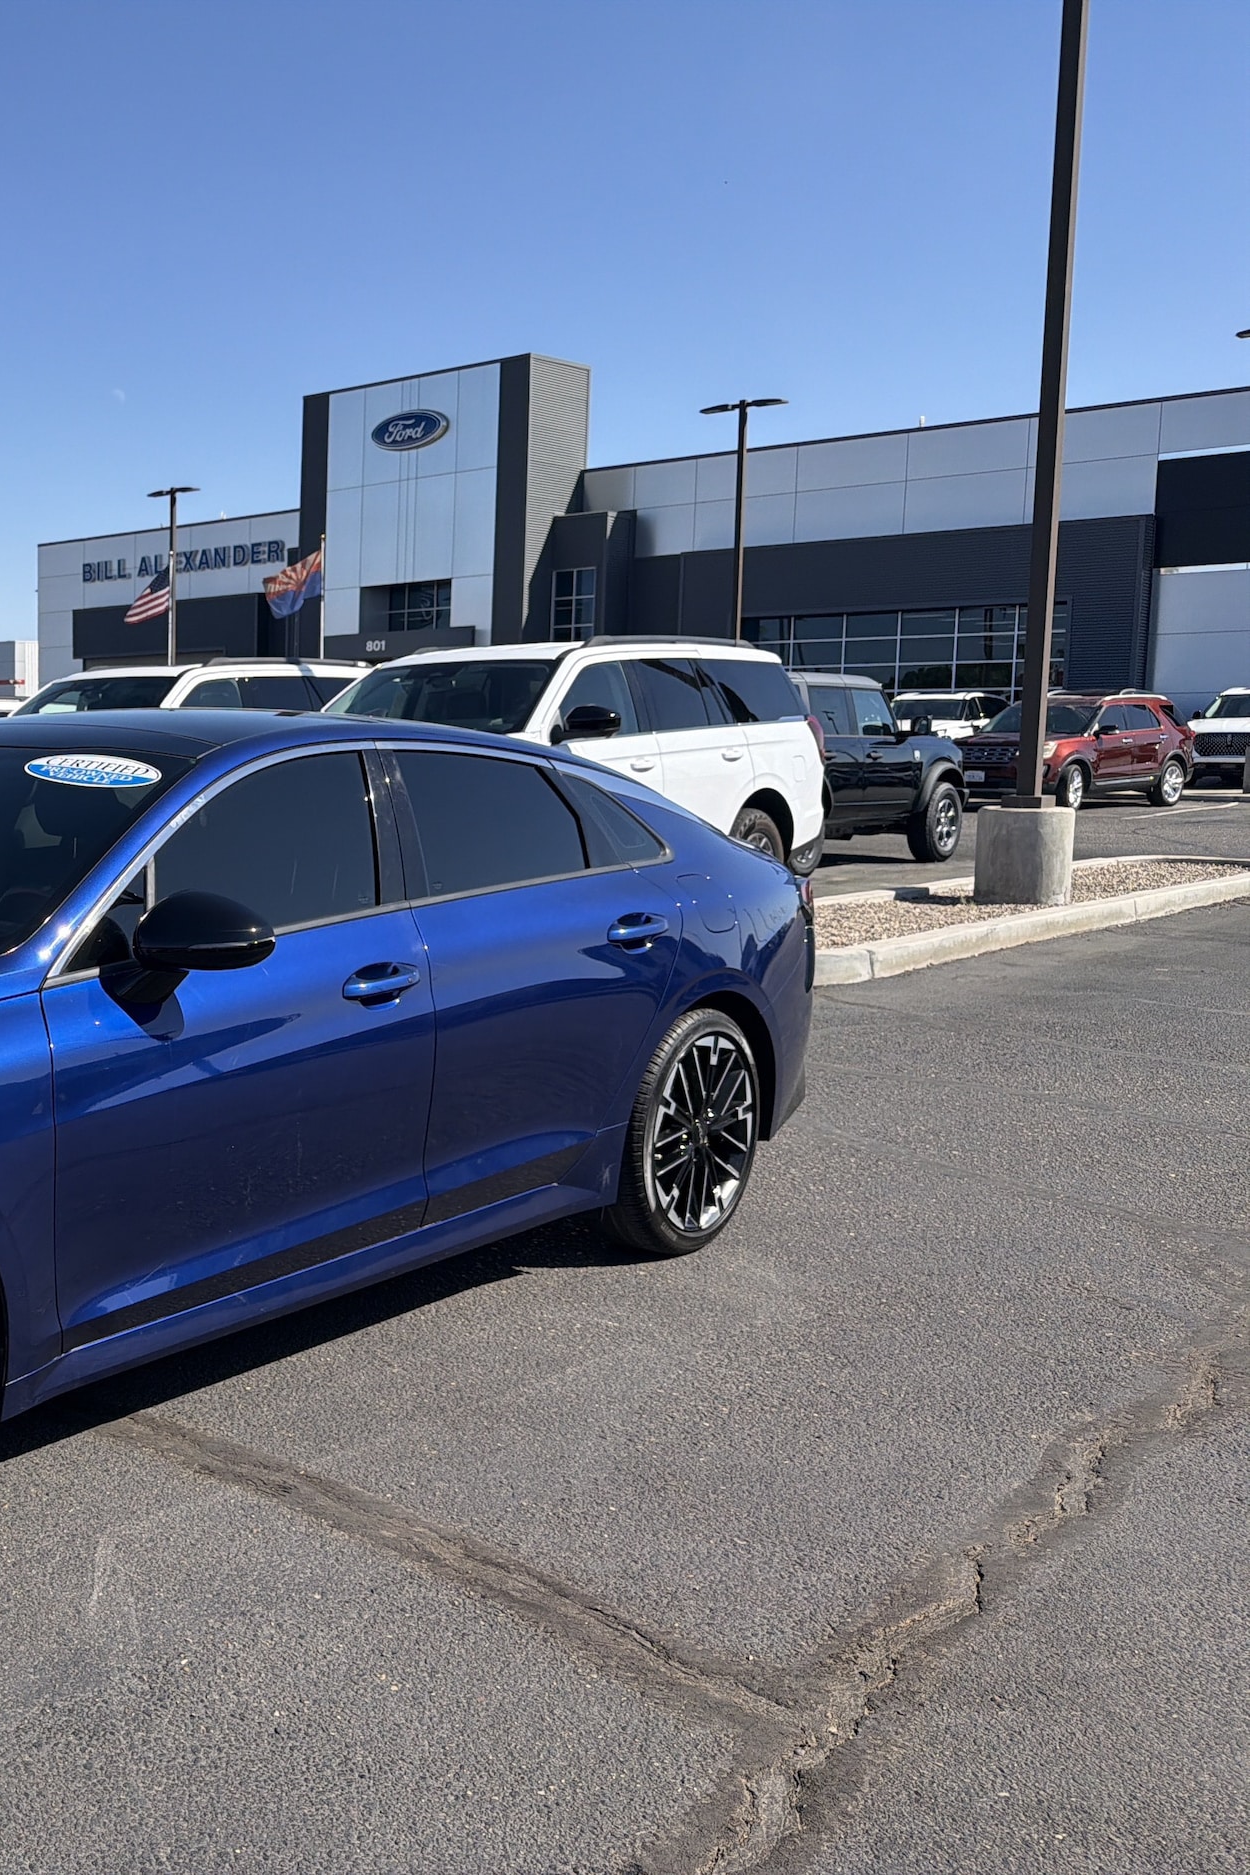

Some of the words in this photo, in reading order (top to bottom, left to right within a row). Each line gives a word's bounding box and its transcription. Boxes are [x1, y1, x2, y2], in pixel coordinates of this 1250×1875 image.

[384, 419, 426, 443] Ford
[82, 558, 131, 582] BILL
[365, 639, 386, 652] 801
[46, 757, 150, 776] CERTIFIED
[49, 771, 111, 785] VEHICLE
